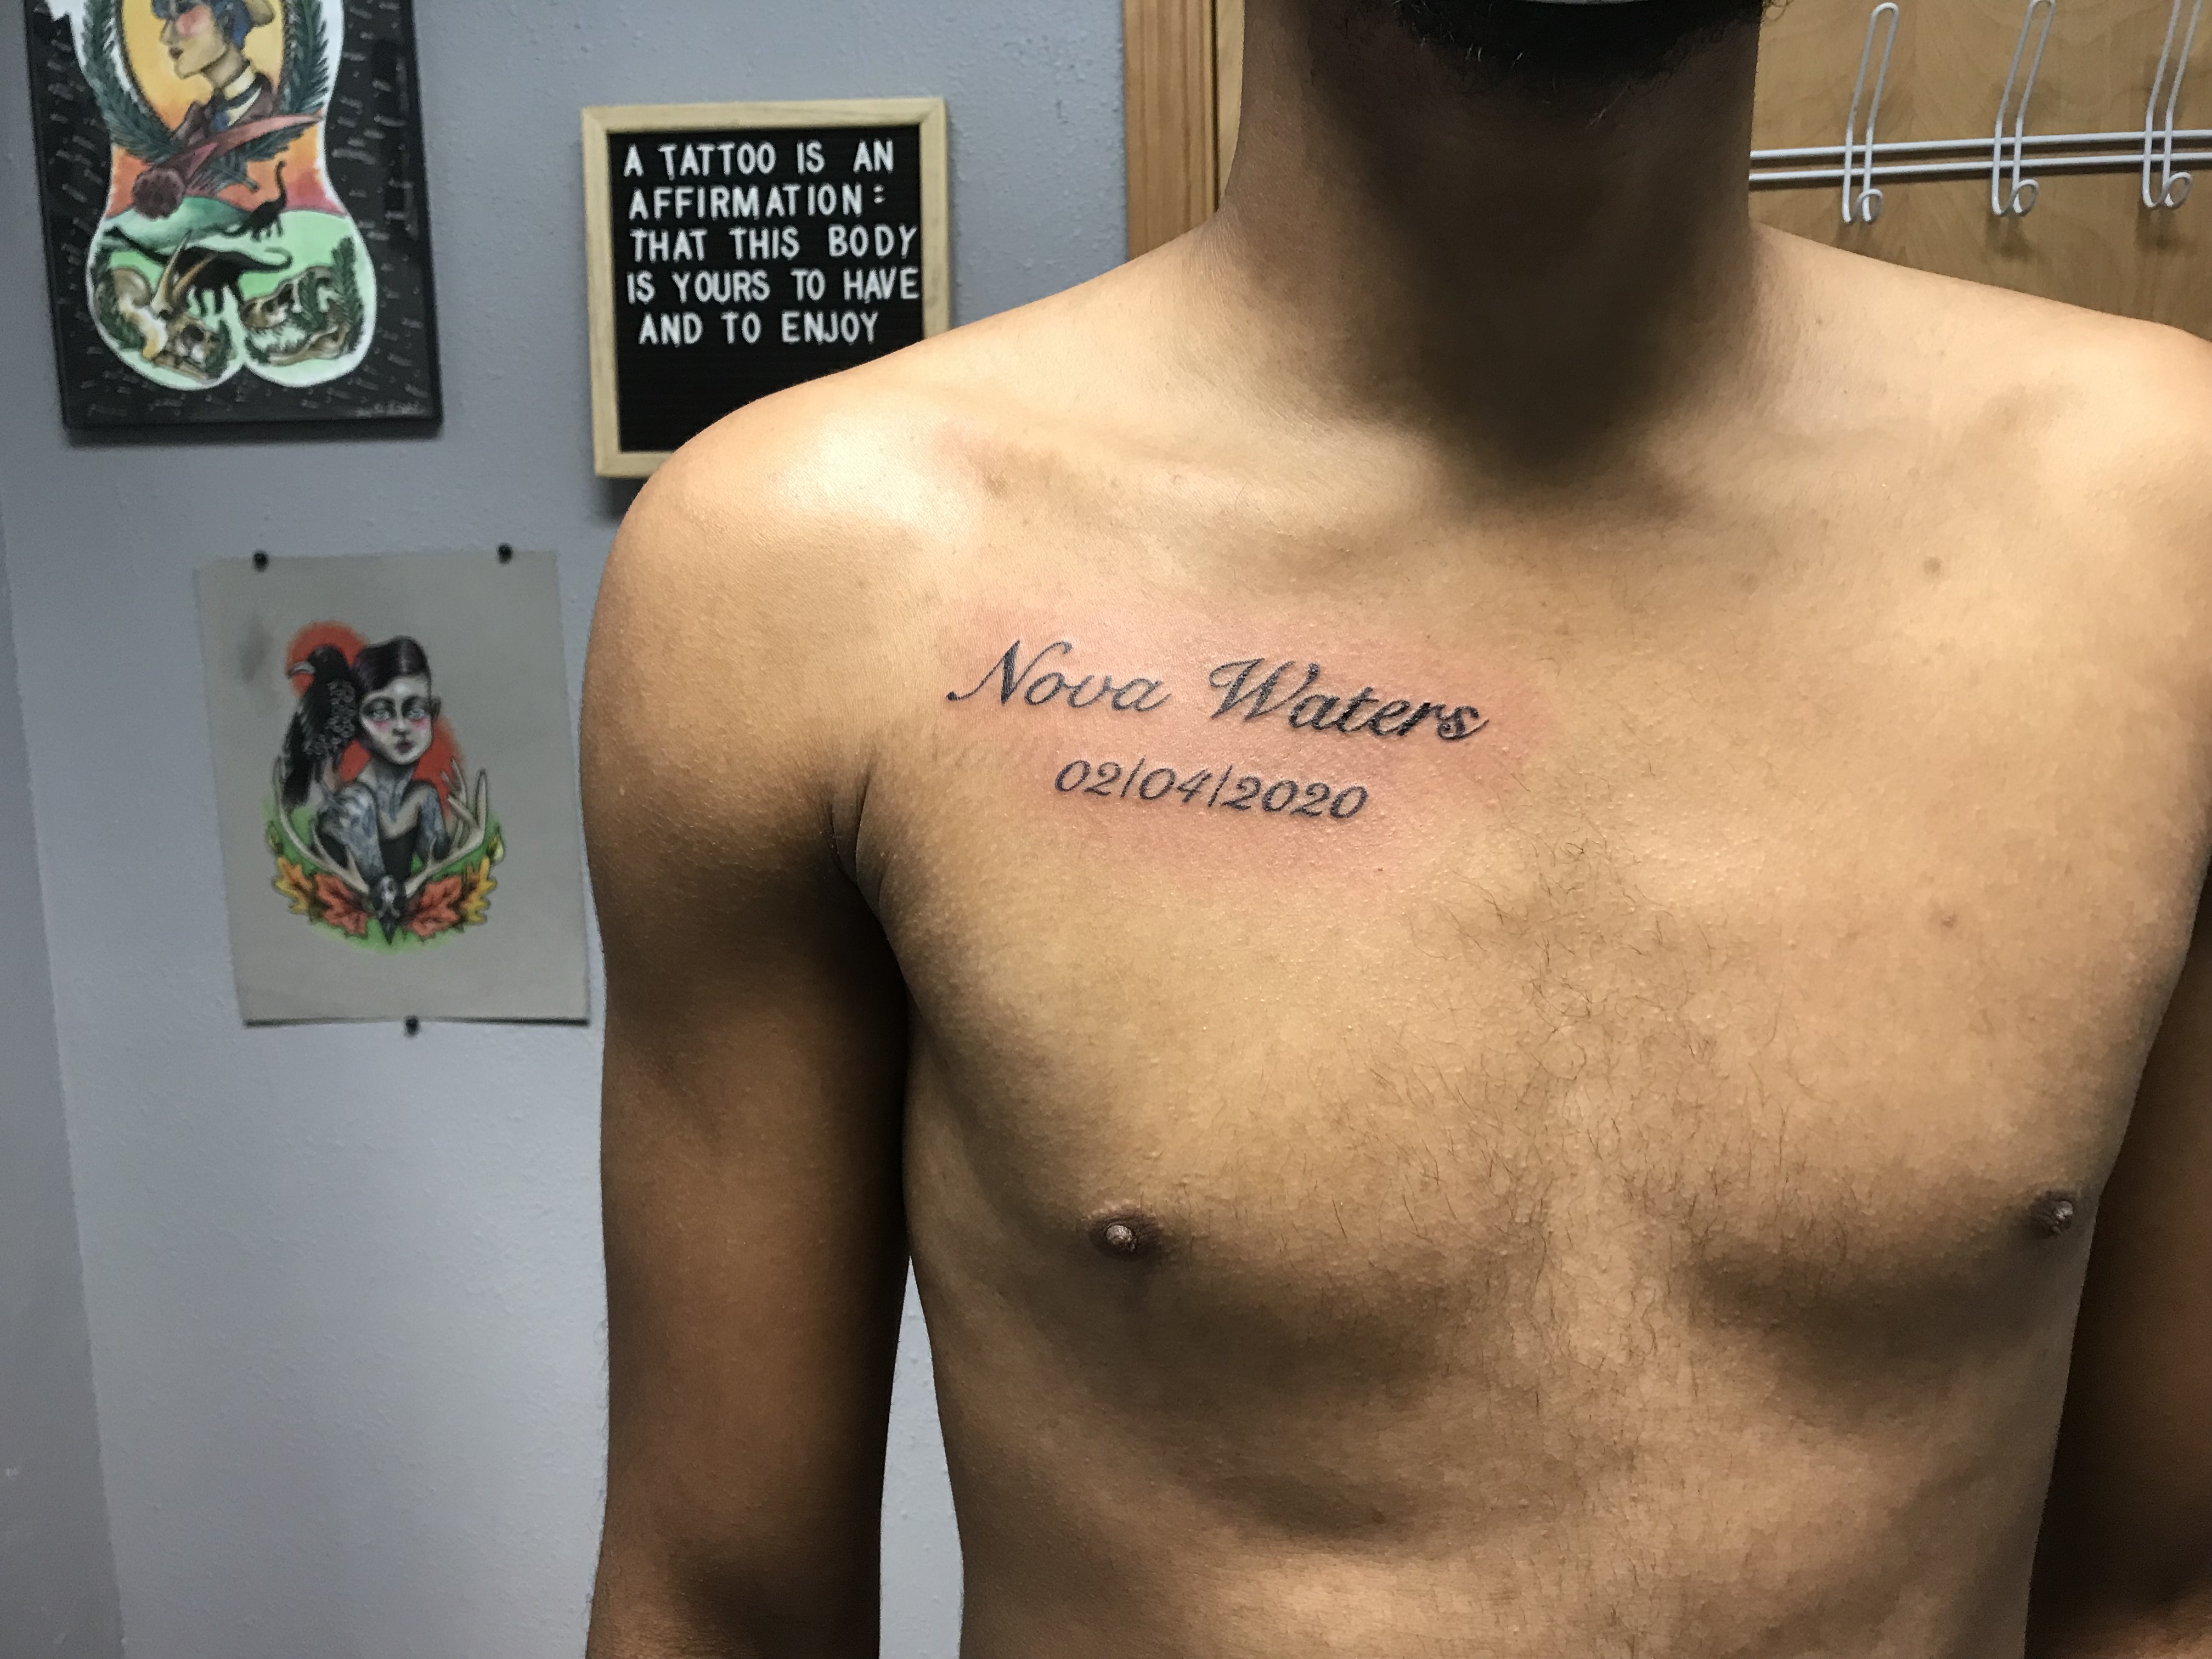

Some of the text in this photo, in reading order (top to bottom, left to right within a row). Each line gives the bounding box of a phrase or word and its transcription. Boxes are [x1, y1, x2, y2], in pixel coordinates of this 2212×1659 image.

[624, 138, 894, 180] A TATTOO IS AN
[630, 223, 918, 262] THAT THIS BODY
[627, 266, 920, 303] IS YOURS TO HAVE
[638, 309, 879, 346] AND TO ENJOY
[945, 639, 1489, 741] Nova Waters
[1054, 757, 1369, 819] 02/04/2020
